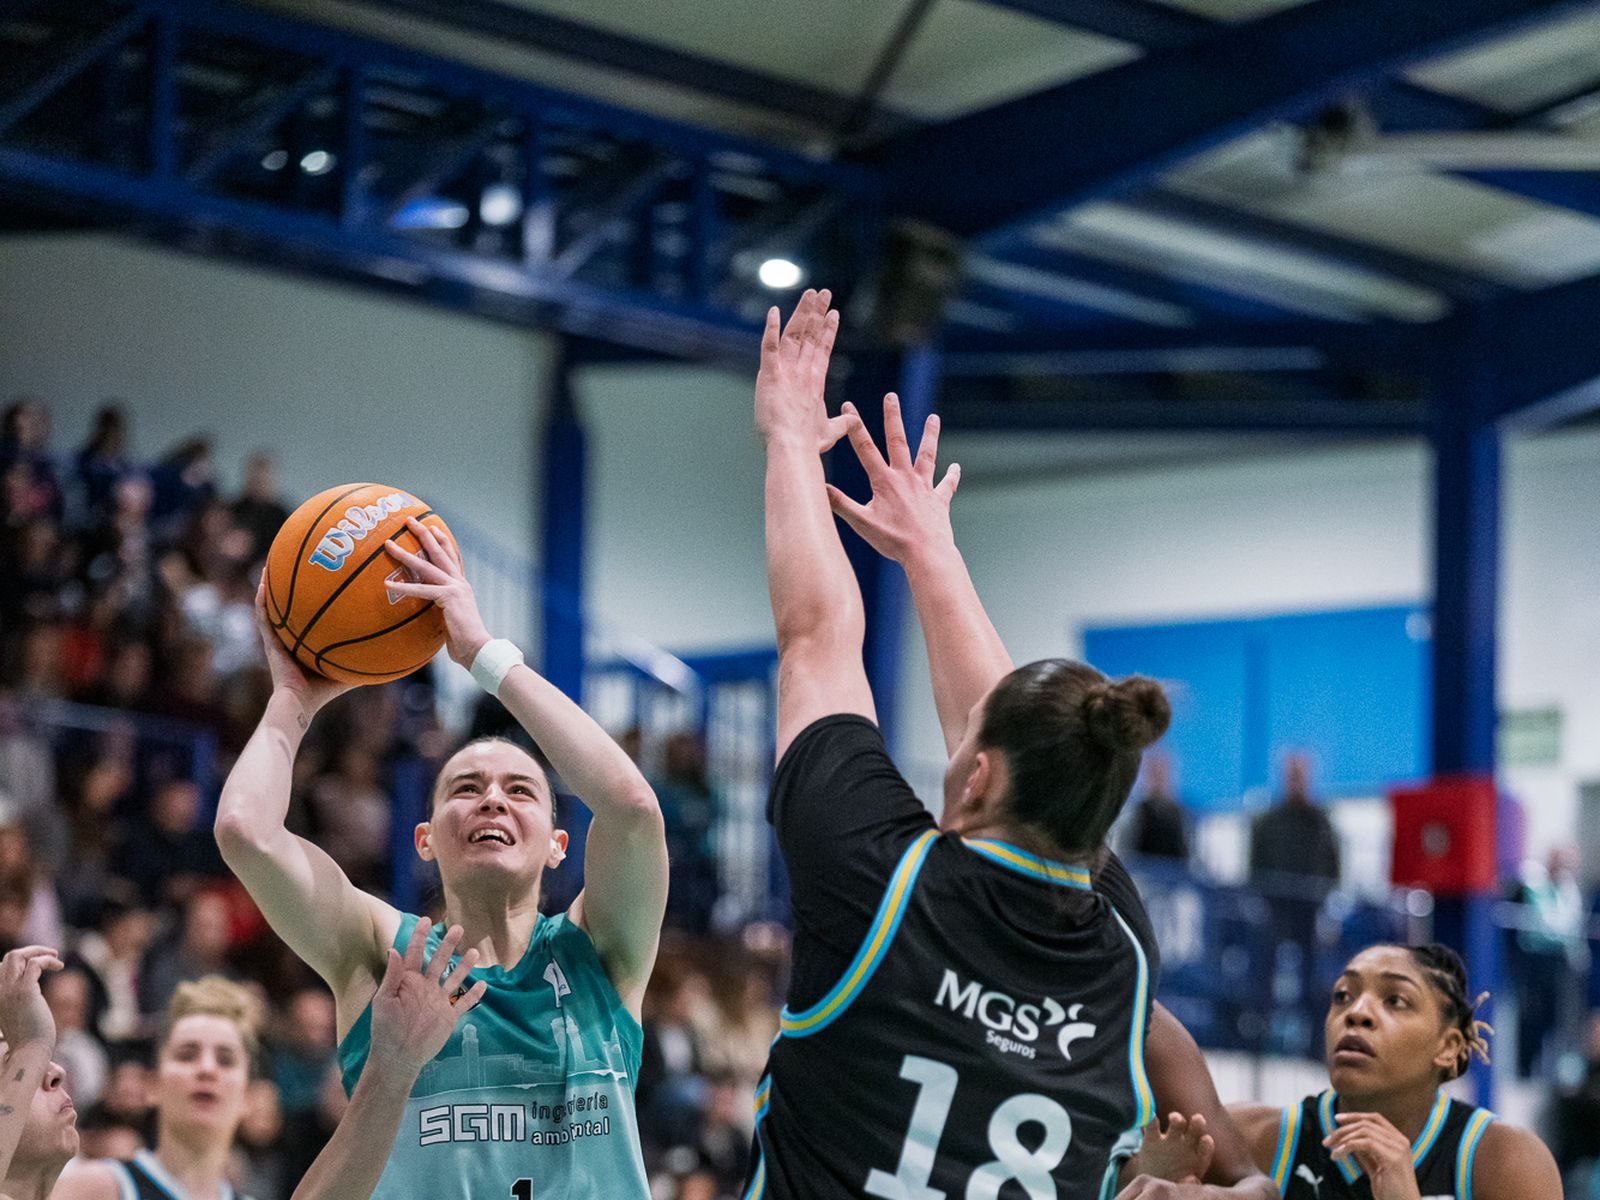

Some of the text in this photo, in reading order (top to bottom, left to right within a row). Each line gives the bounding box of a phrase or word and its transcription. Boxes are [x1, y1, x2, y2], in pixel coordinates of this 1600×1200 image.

[934, 968, 1042, 1041] MGS
[986, 1029, 1036, 1060] Seguros
[420, 1104, 526, 1146] SGM
